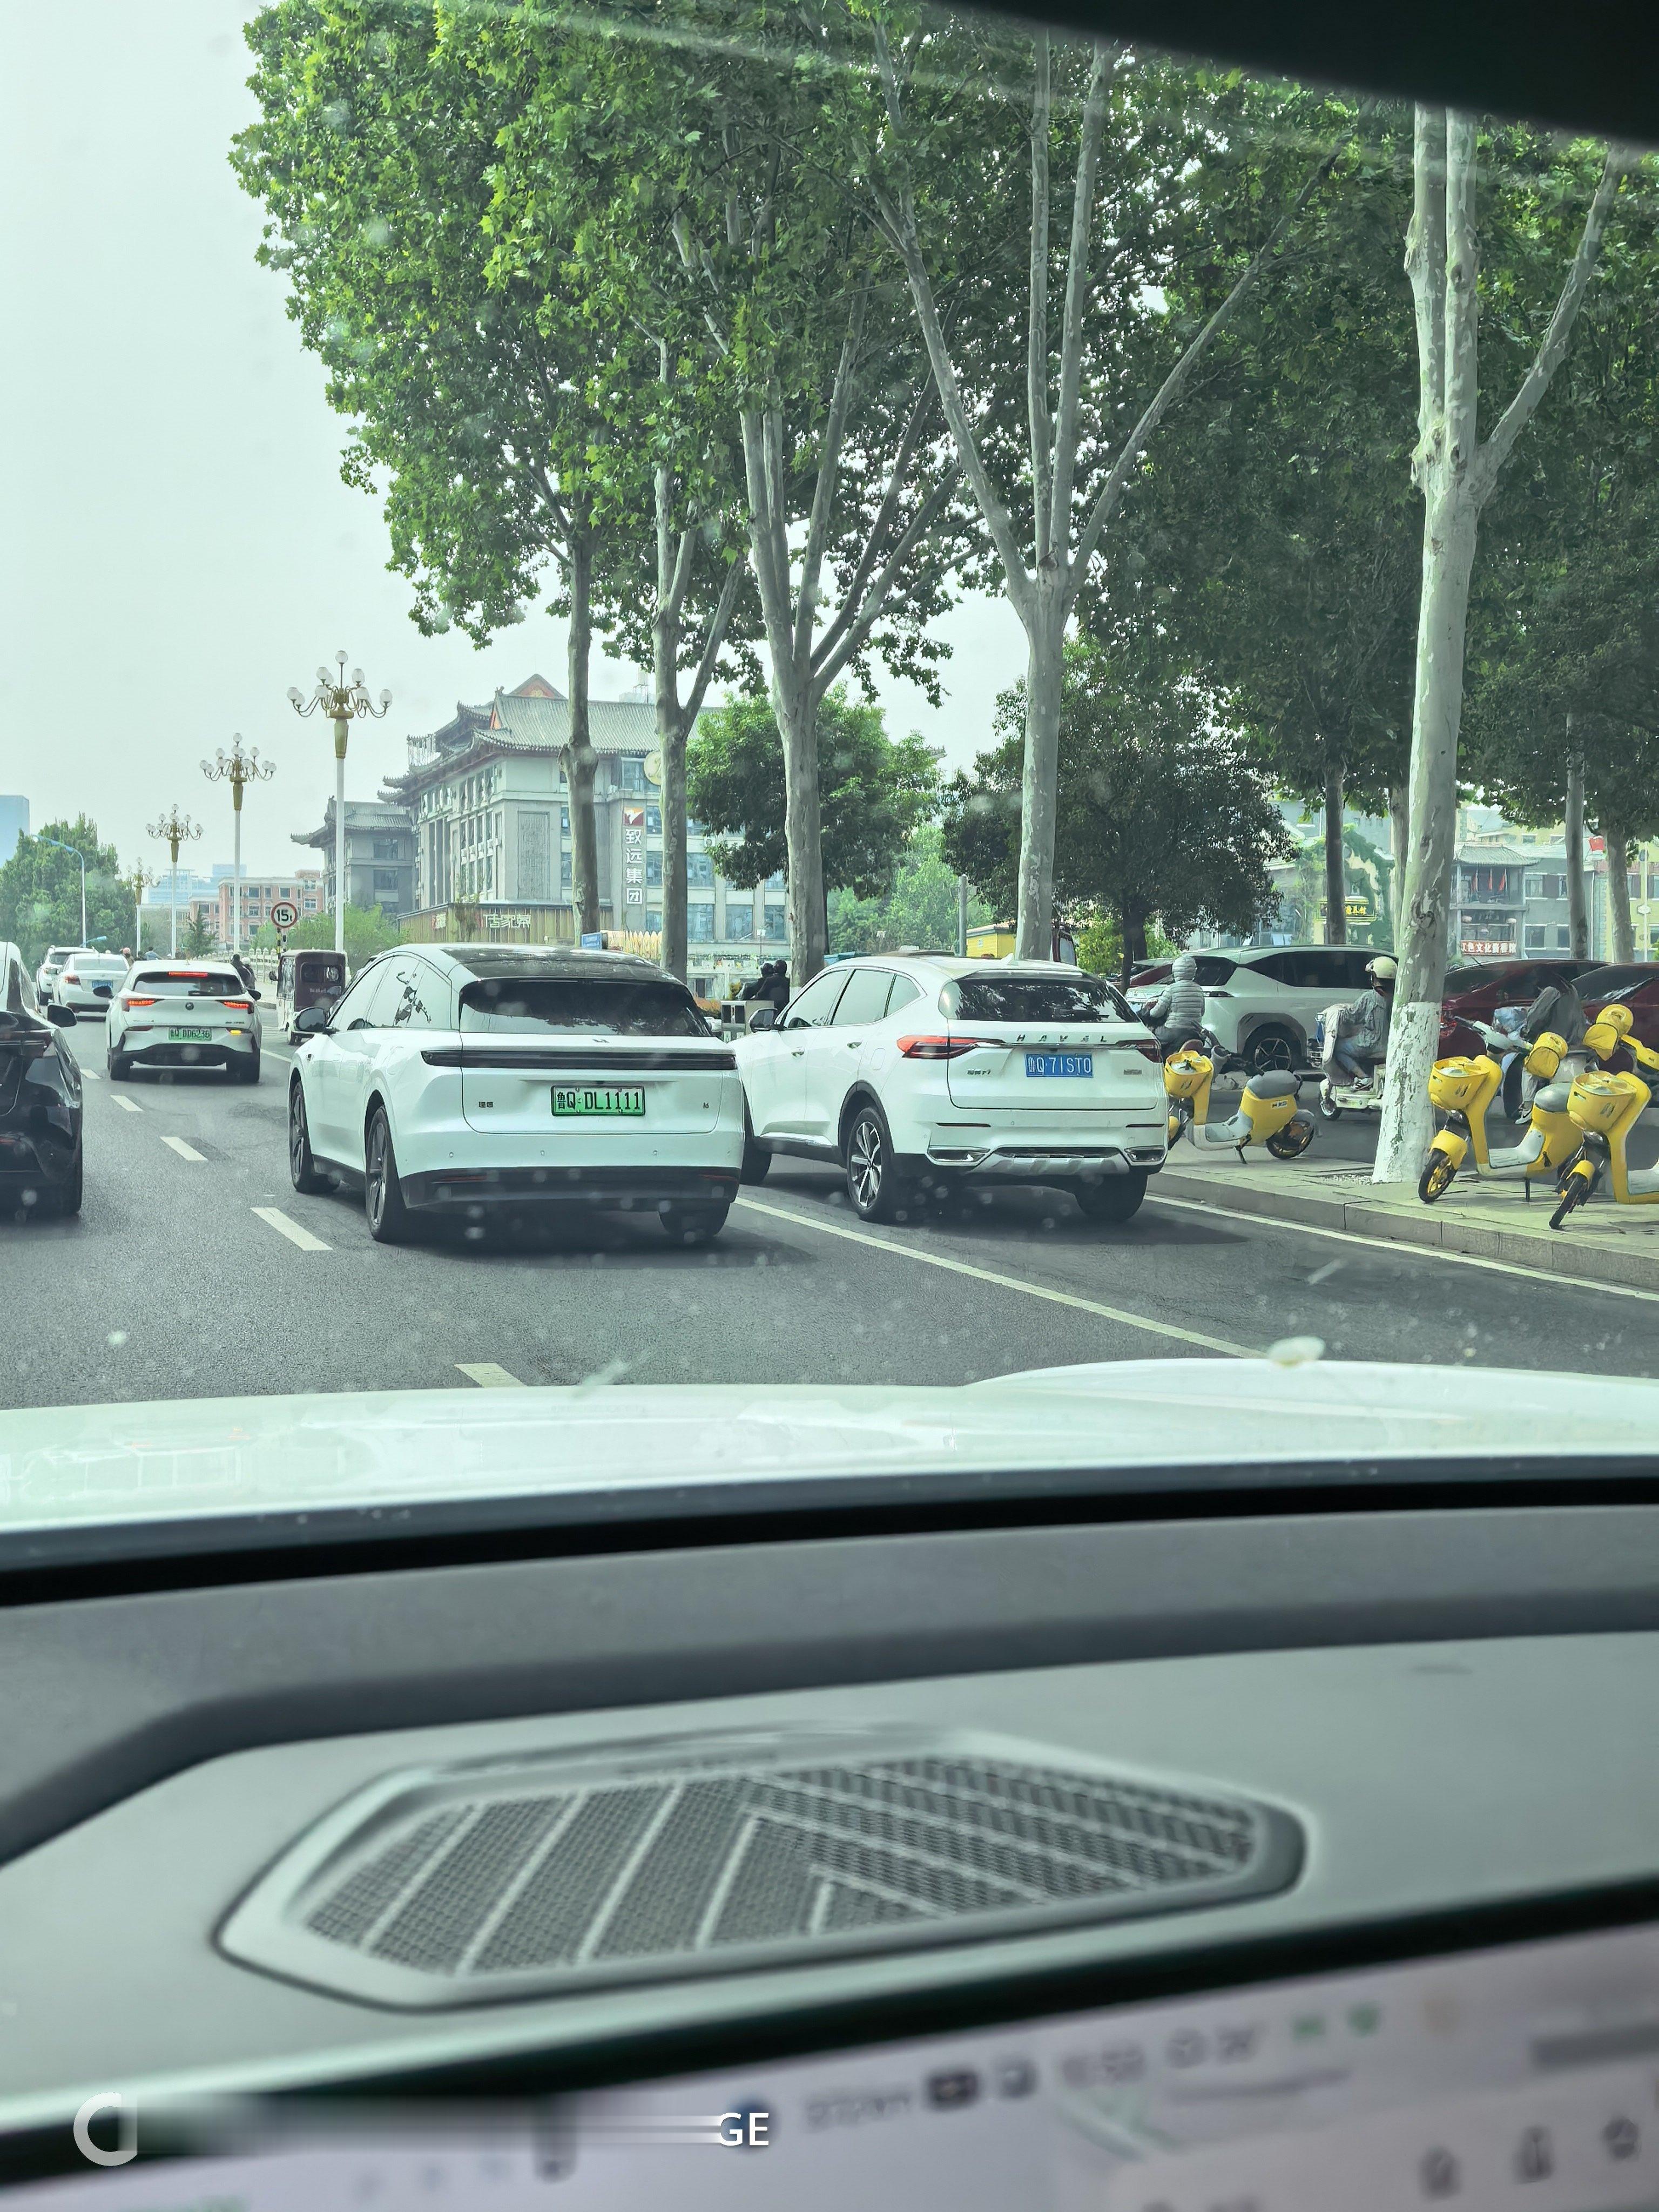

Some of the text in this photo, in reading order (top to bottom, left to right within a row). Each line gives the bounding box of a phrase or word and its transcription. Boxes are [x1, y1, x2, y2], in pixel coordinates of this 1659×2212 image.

[625, 828, 643, 905] 致远集团
[1016, 1034, 1107, 1042] HAVAL
